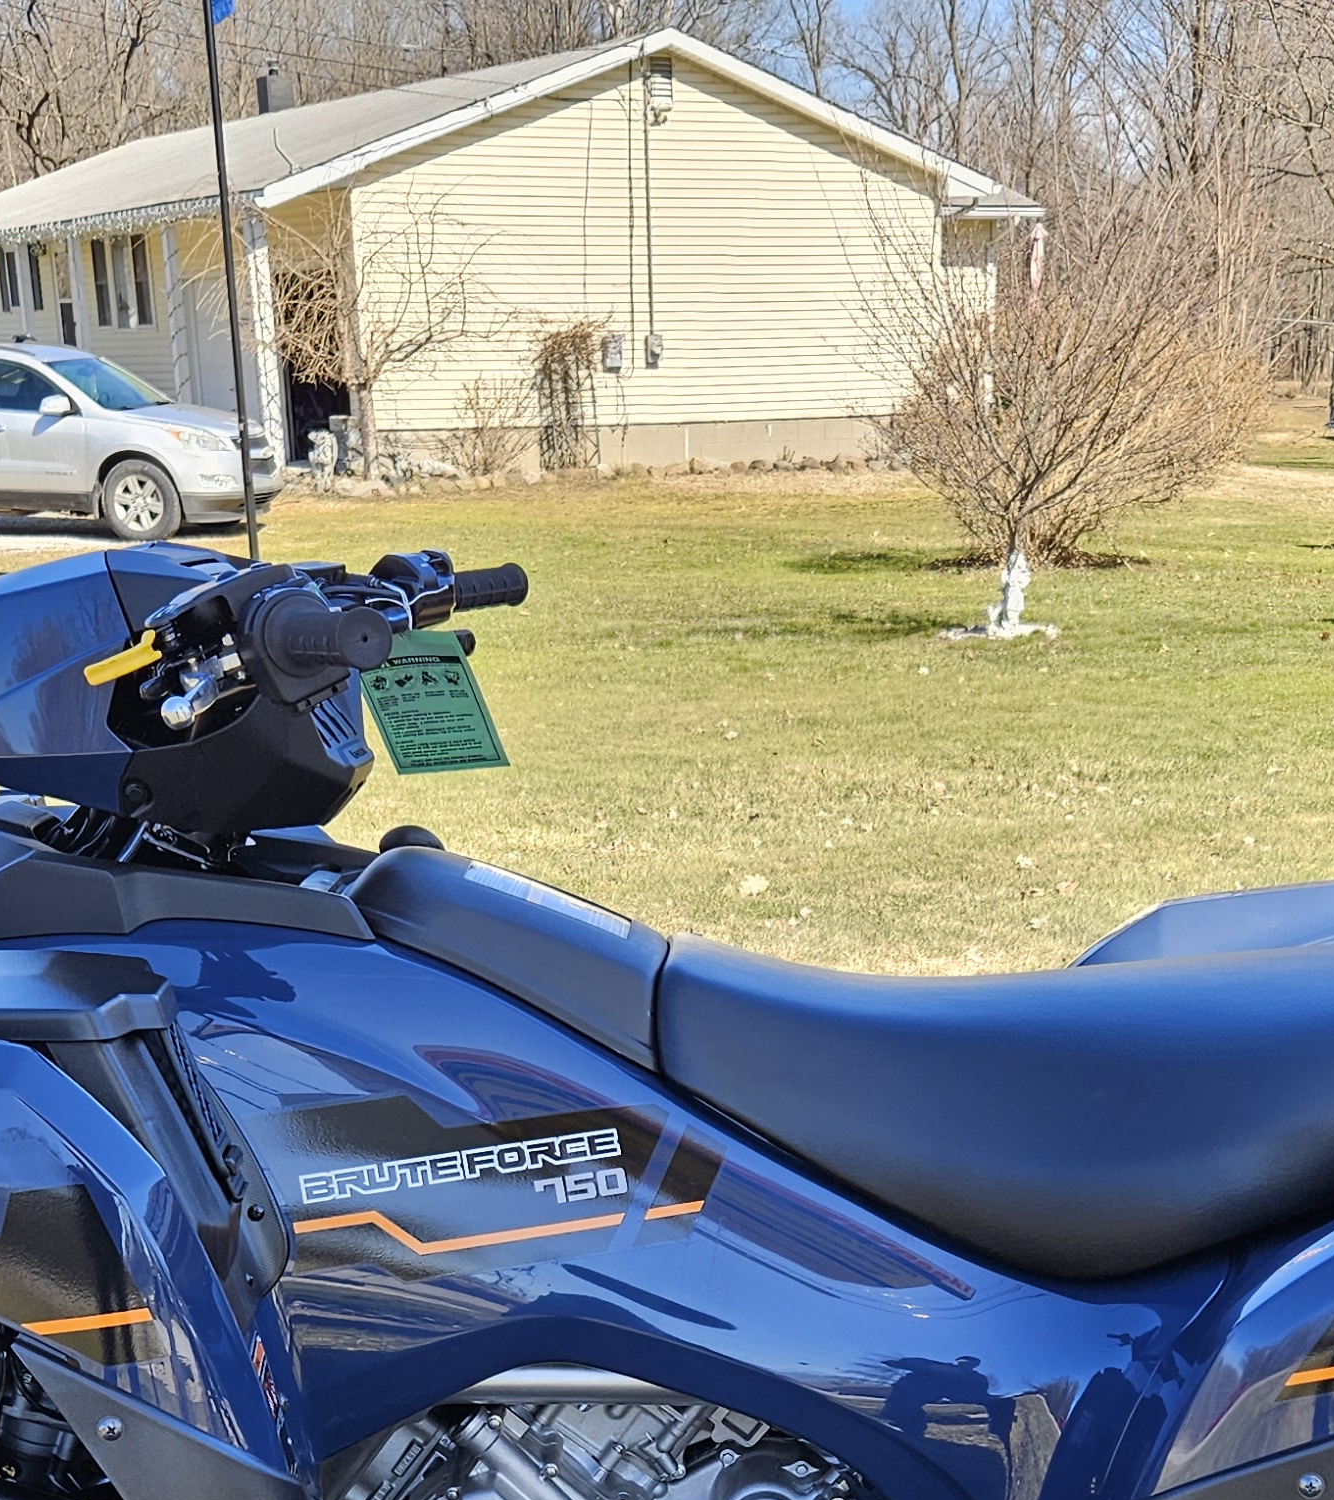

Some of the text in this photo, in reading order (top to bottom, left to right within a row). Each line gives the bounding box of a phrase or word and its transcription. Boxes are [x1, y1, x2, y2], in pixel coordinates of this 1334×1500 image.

[392, 656, 440, 665] WARNING
[299, 1127, 621, 1205] BRUTE FORCE
[534, 1167, 629, 1204] 750
